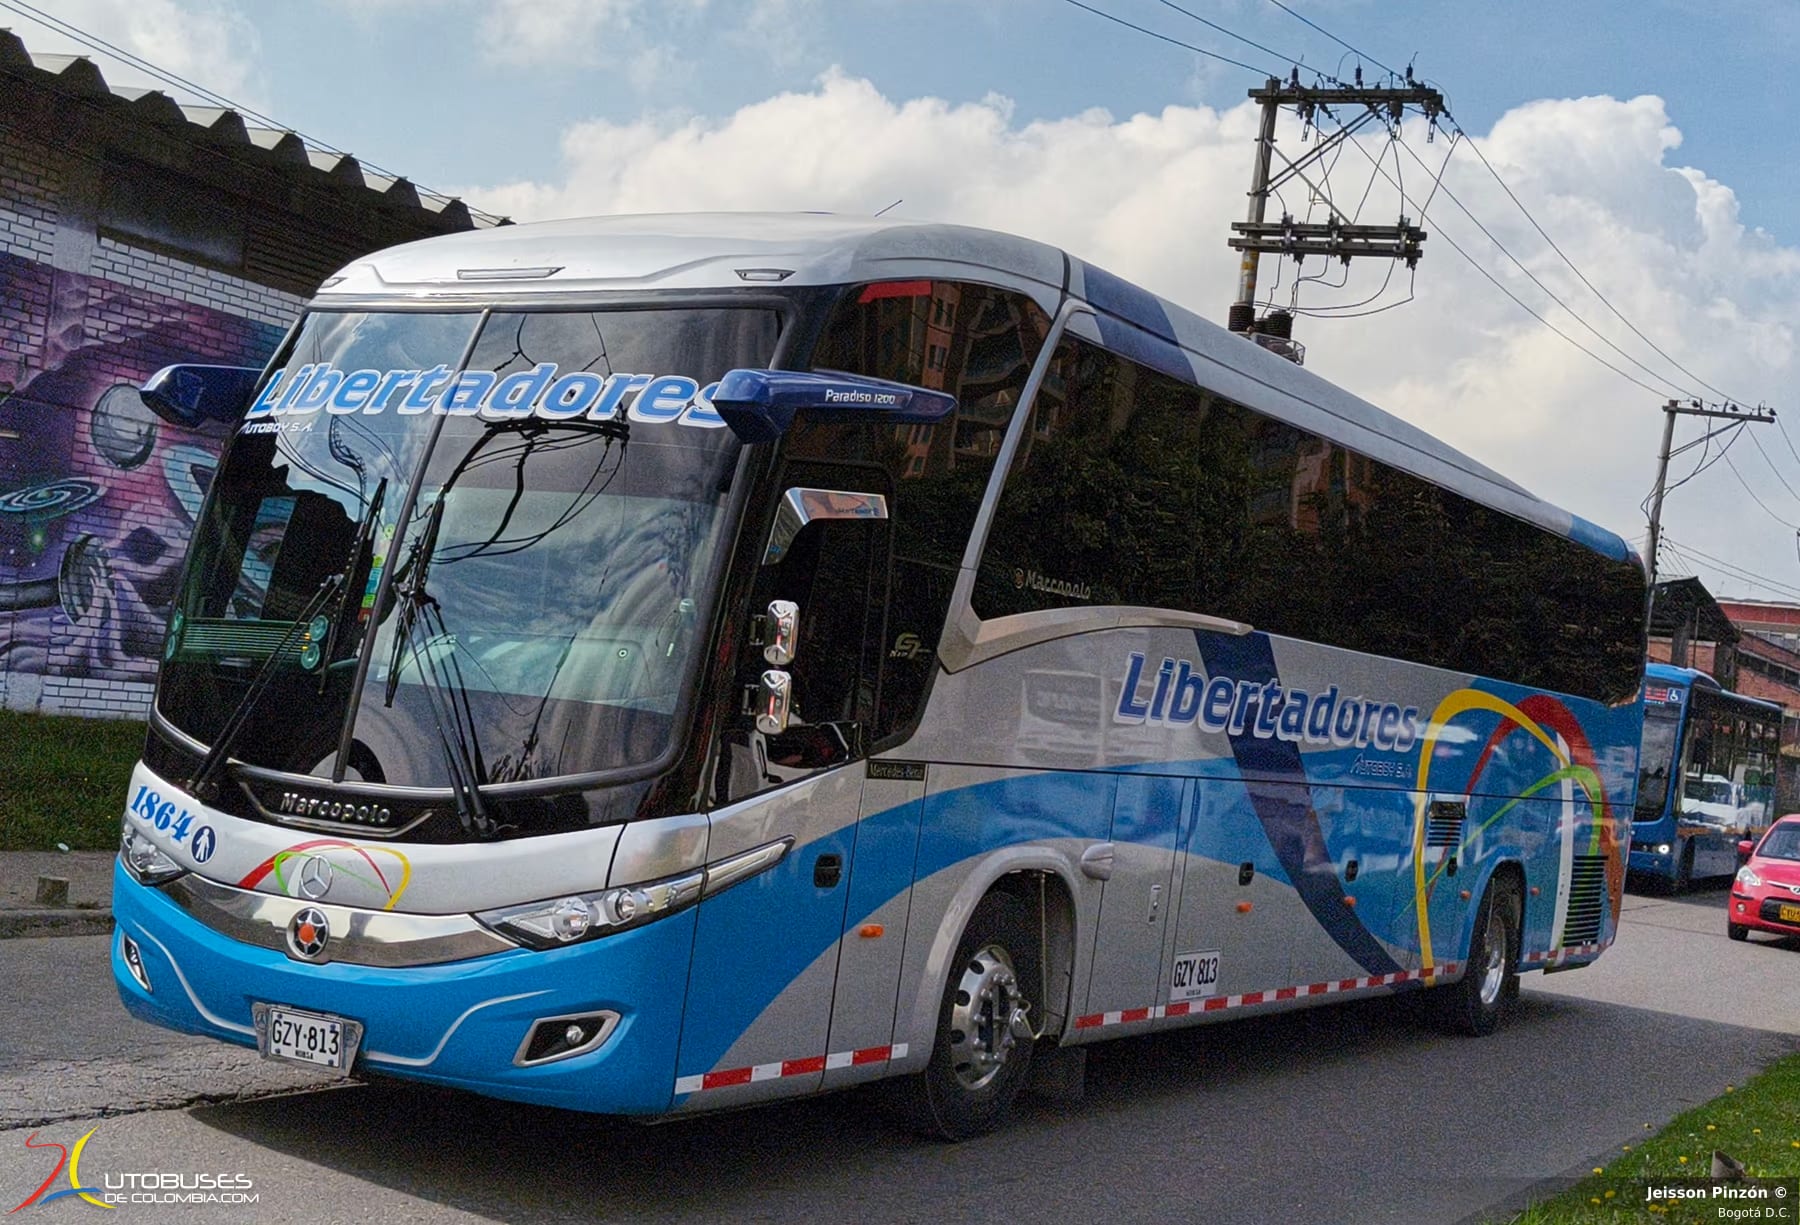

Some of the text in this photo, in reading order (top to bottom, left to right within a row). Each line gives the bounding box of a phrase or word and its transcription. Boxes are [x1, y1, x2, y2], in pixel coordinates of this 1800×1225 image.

[244, 362, 727, 428] Libertadores
[825, 389, 896, 404] Paradiso 1200
[1025, 570, 1091, 600] Marcopolo
[1113, 651, 1419, 751] Libertadores
[130, 786, 194, 842] 1864
[280, 792, 390, 823] Marcopolo
